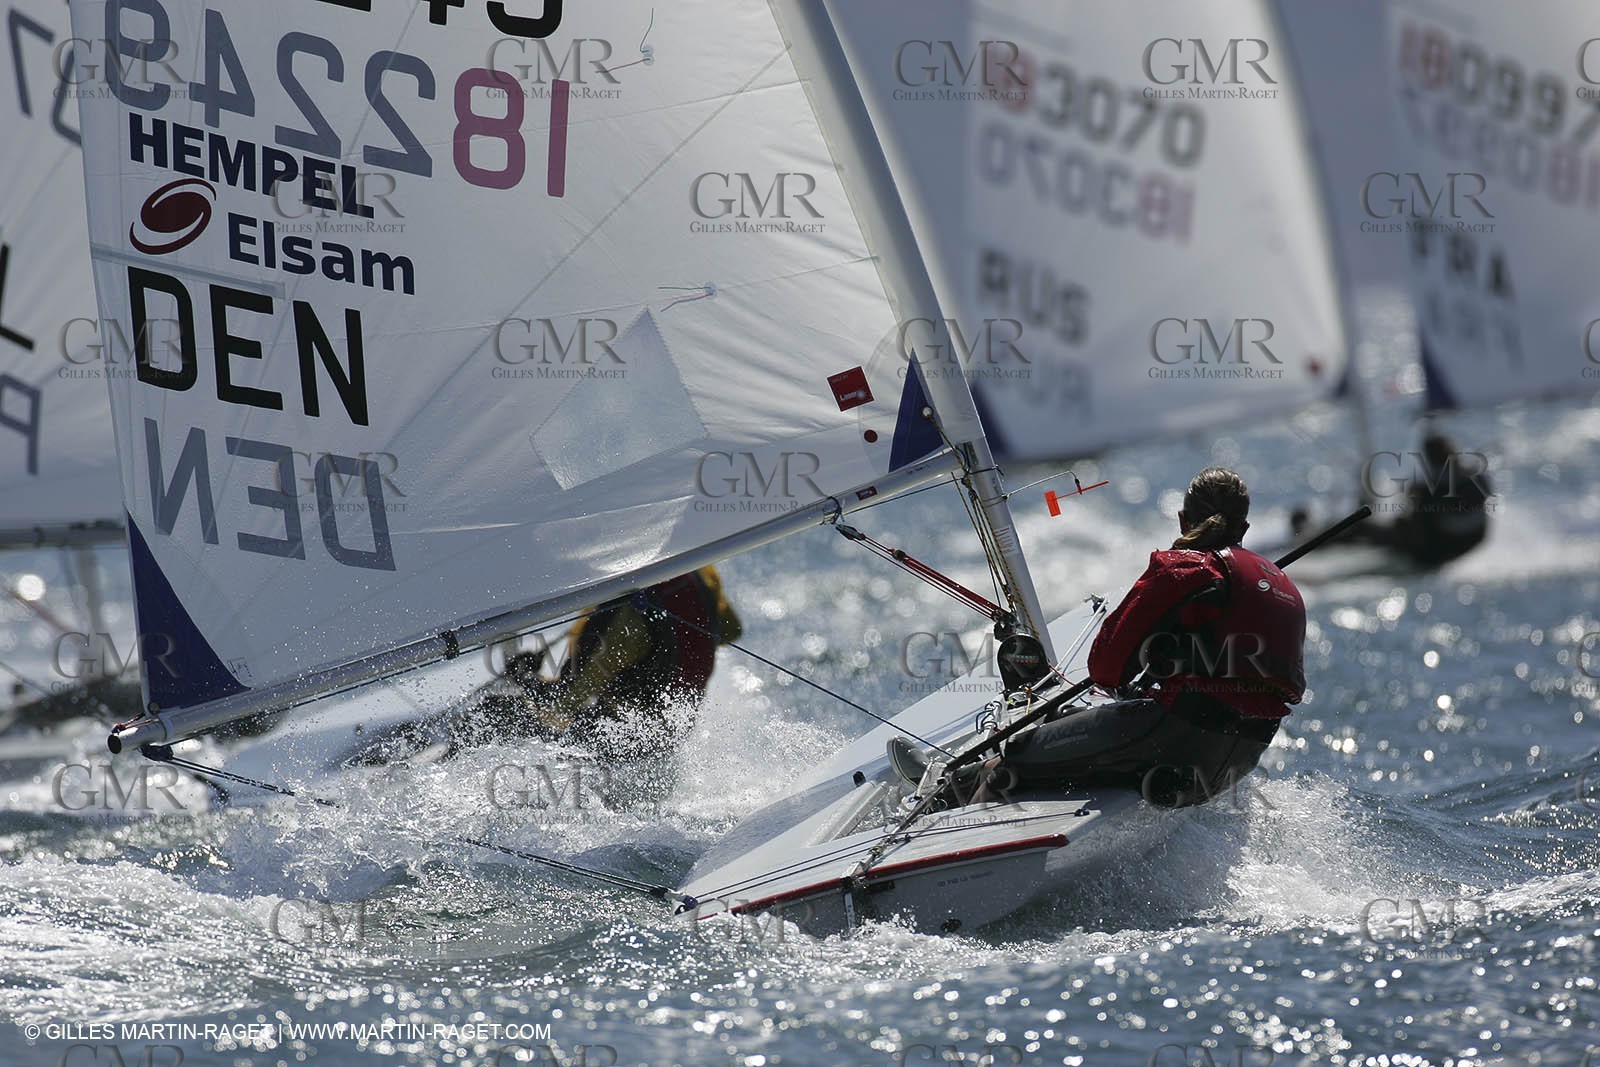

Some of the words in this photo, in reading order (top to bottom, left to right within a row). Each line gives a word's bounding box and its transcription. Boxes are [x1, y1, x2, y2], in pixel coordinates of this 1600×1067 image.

[129, 112, 374, 218] HEMPEL
[228, 212, 415, 295] Elsam
[978, 248, 1093, 347] RUS
[128, 266, 369, 427] DEN
